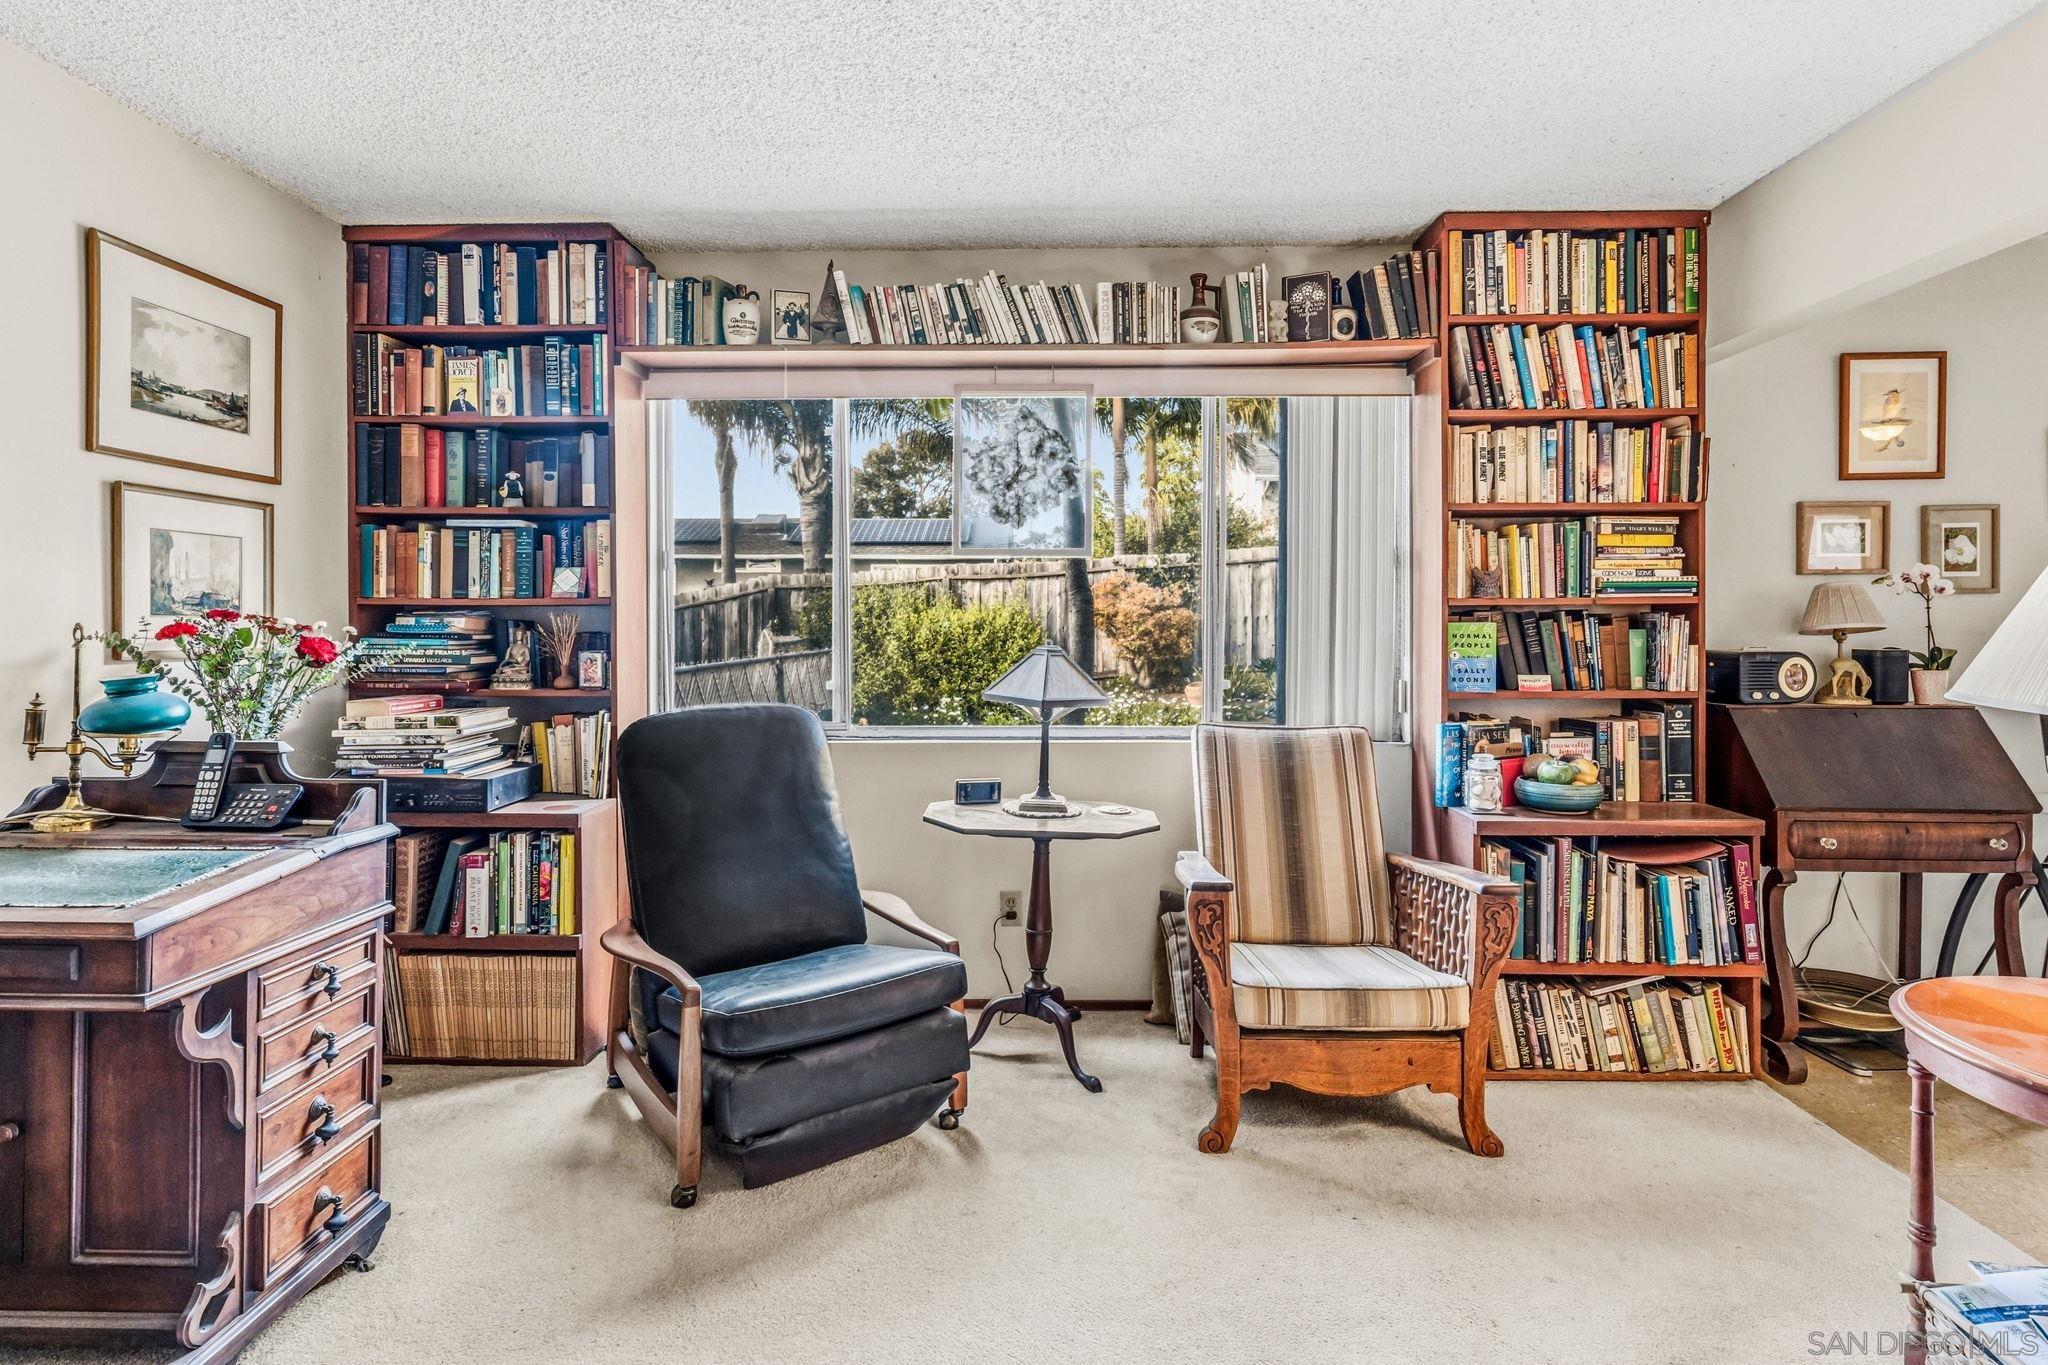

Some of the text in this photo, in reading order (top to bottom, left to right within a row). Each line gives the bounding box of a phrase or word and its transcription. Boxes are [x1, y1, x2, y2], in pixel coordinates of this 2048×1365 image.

[1466, 267, 1475, 290] NUN
[1486, 342, 1500, 384] FLOWER NET
[1473, 732, 1490, 741] LISA
[1726, 886, 1737, 925] NAKED
[1712, 989, 1726, 1031] WESTWARD
[1723, 1047, 1733, 1065] RIO
[1519, 1045, 1530, 1063] MORE
